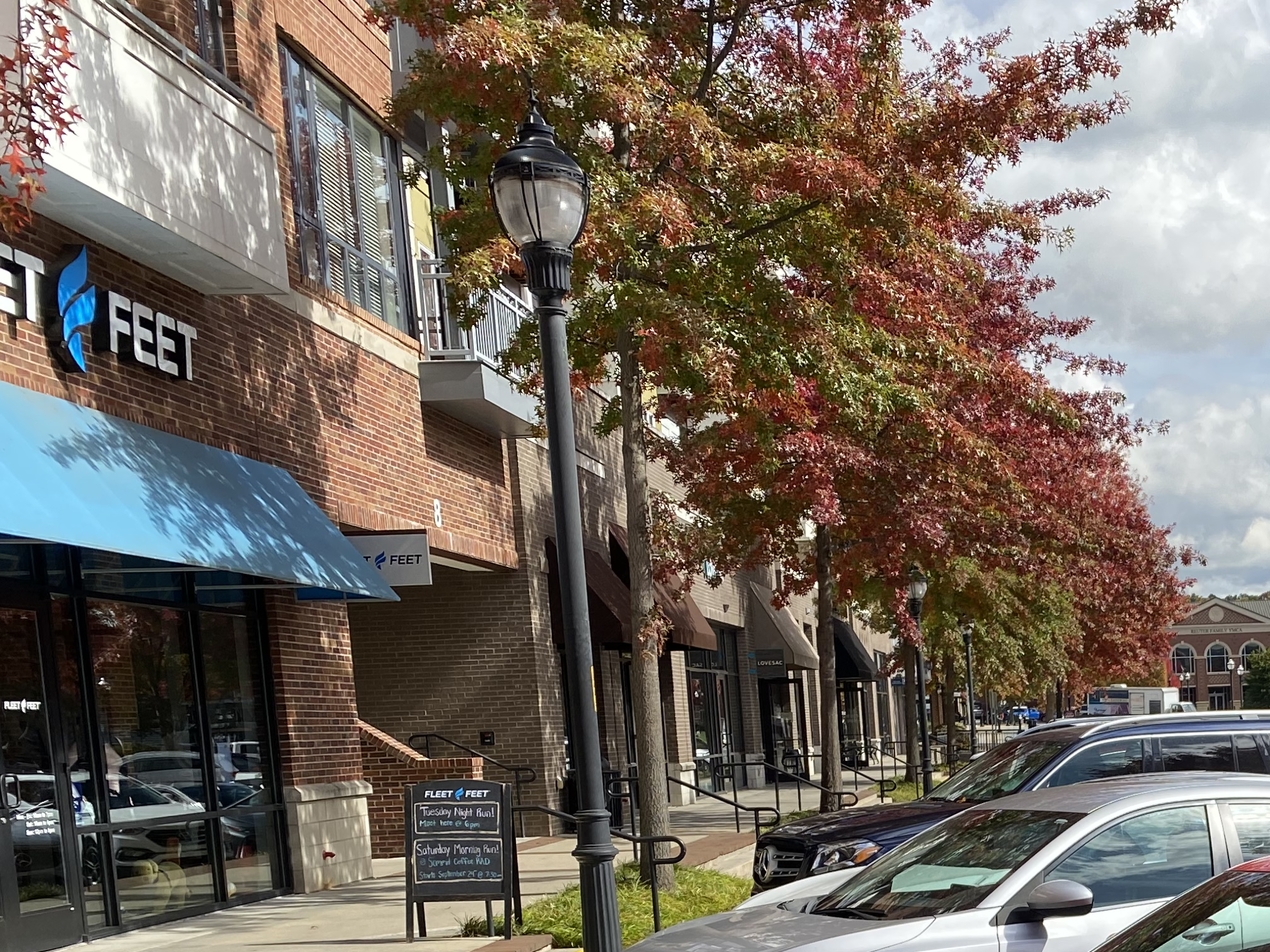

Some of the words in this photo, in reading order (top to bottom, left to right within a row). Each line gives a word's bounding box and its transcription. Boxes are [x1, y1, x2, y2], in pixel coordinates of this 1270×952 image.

[108, 290, 197, 381] FEET
[433, 498, 442, 528] 8
[389, 554, 422, 566] FEET
[4, 700, 20, 710] FLEET
[26, 701, 41, 710] FEET
[424, 790, 454, 798] FLEET
[465, 790, 490, 798] FEET
[420, 806, 452, 818] Tuesday
[453, 807, 473, 819] Night
[476, 807, 495, 818] Run!
[416, 844, 451, 857] Saturday
[453, 844, 481, 857] Morning
[482, 844, 499, 854] Run!
[453, 857, 474, 865] Coffee
